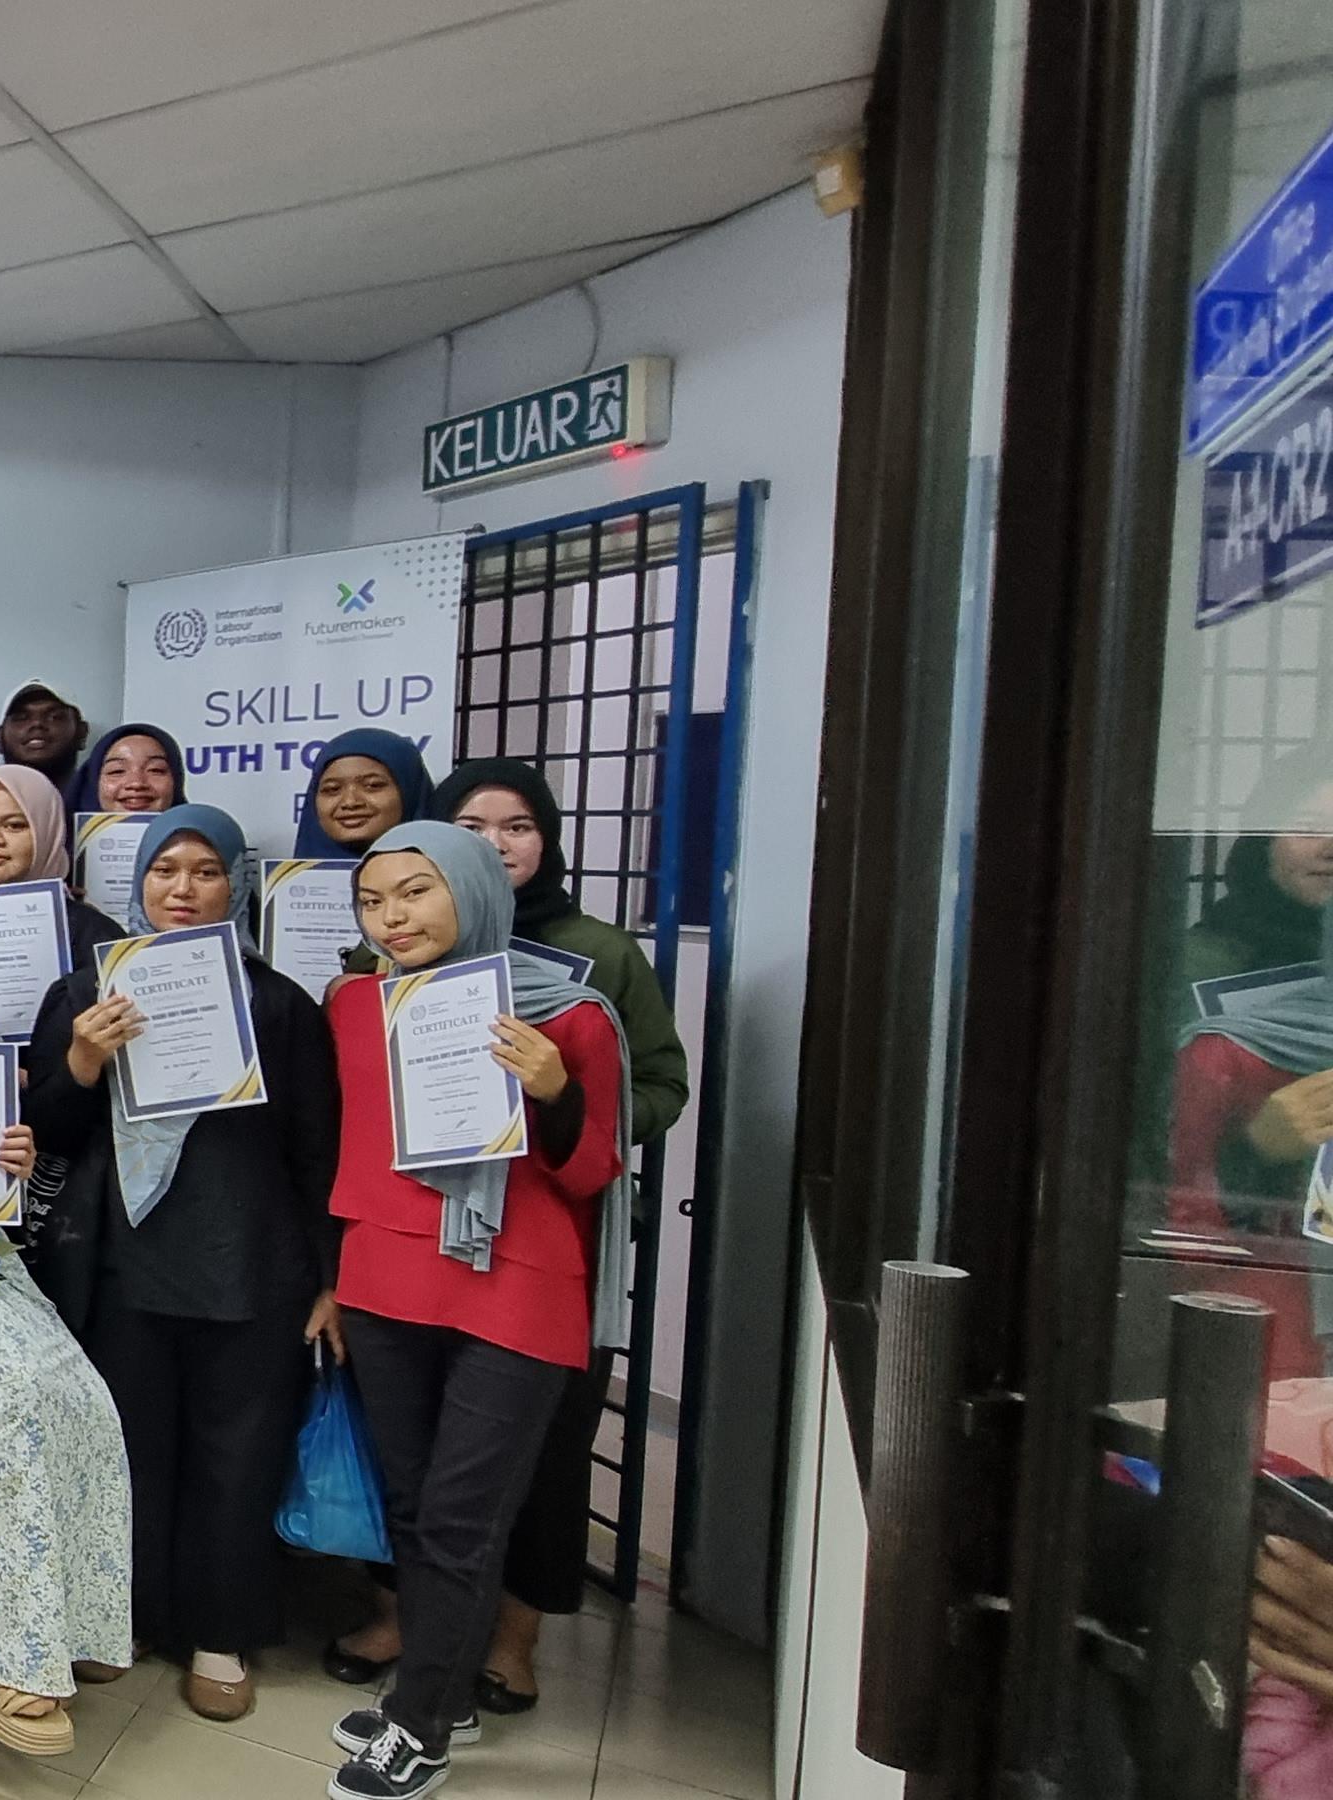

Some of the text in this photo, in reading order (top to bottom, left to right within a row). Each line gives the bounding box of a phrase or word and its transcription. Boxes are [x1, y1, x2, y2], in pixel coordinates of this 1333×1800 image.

[429, 391, 581, 483] KELUAR
[215, 601, 283, 620] International
[215, 622, 253, 634] Labour
[305, 615, 406, 636] futuremakers
[215, 631, 283, 648] Organization
[204, 674, 434, 728] SKILL UP
[185, 743, 264, 775] UTH
[290, 902, 353, 911] CERTIFICAT
[133, 975, 212, 997] CERTIFICATE
[413, 1012, 482, 1036] CERTIFICATE
